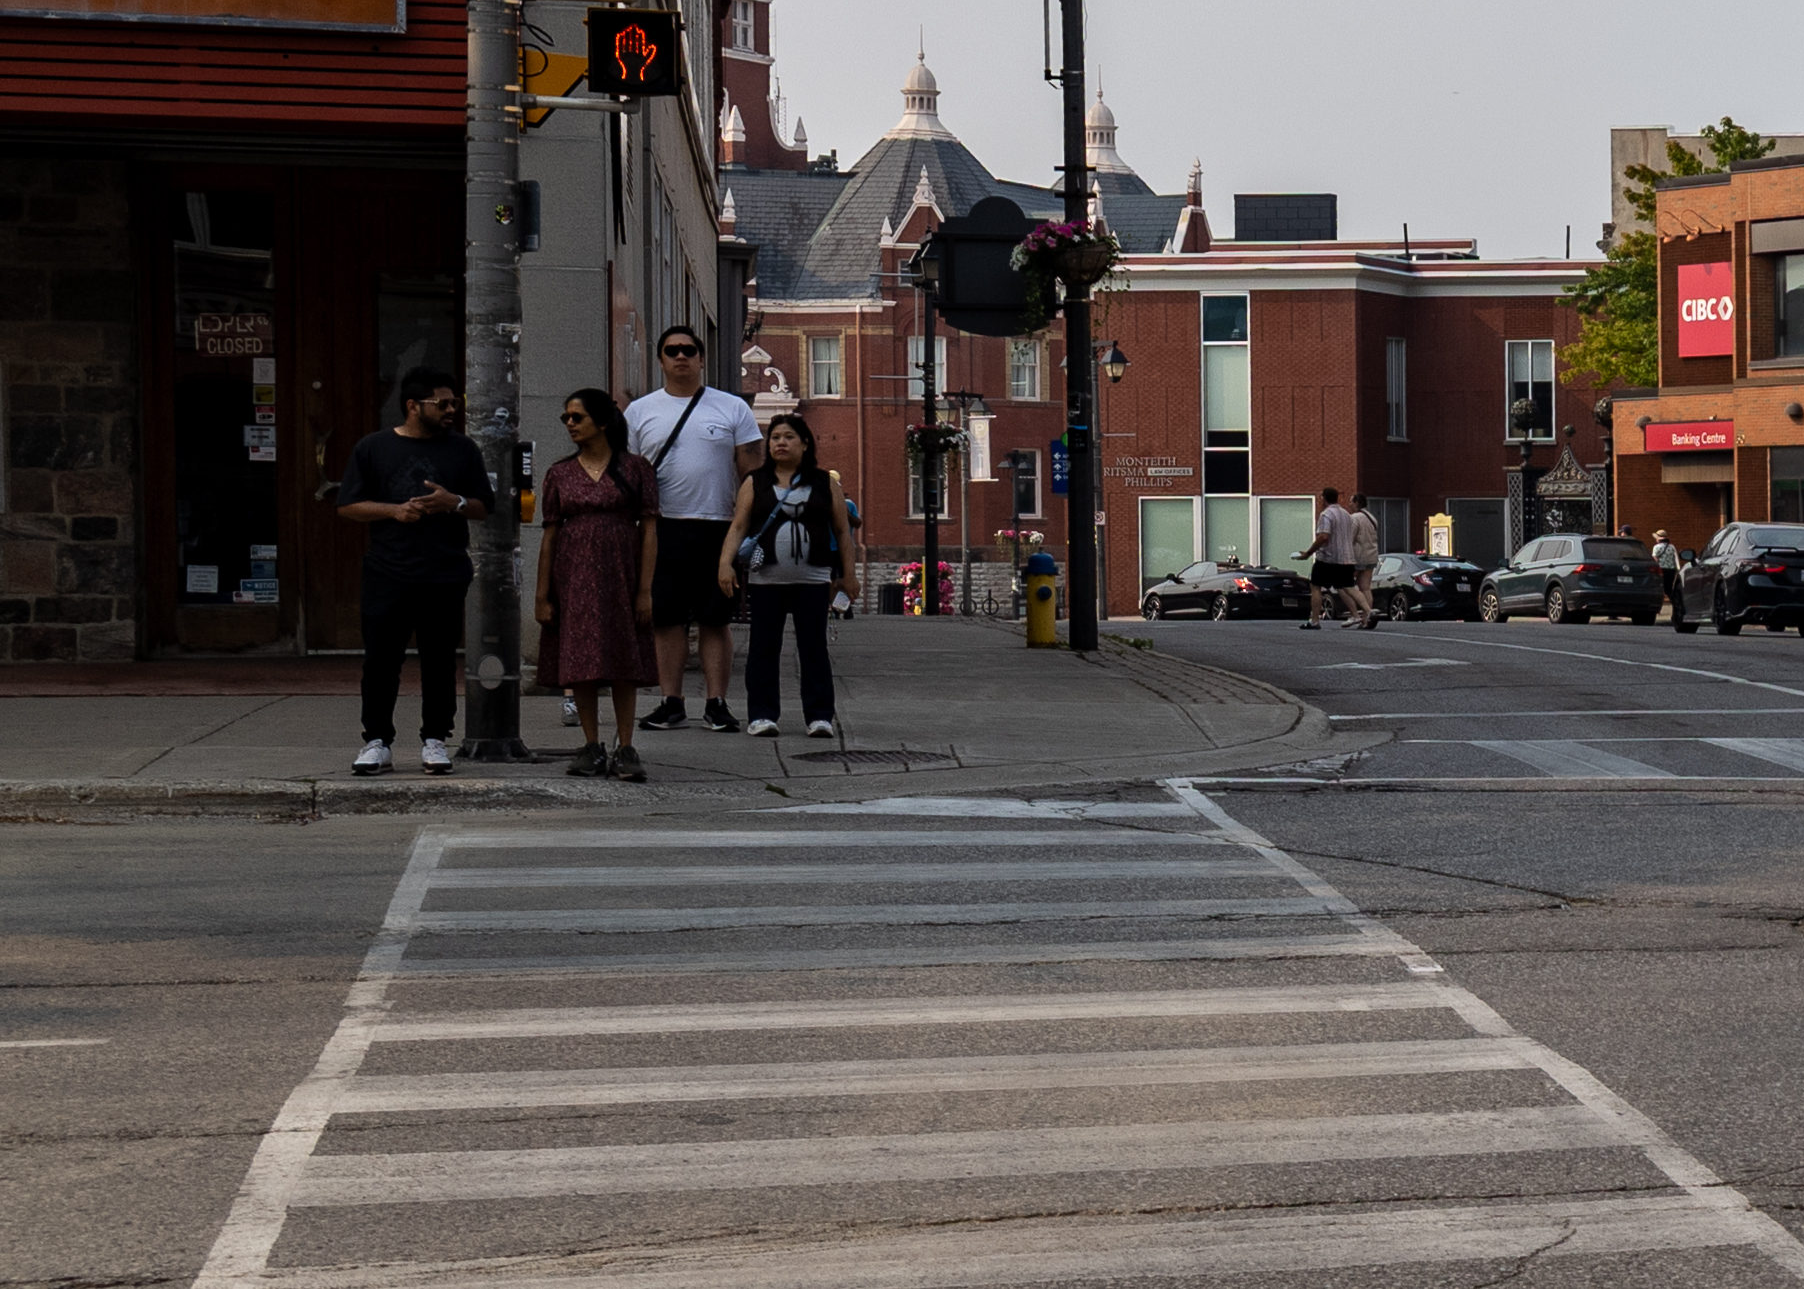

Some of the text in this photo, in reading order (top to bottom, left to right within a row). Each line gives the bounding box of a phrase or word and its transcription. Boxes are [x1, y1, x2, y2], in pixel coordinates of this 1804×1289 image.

[1681, 298, 1718, 322] CIBC
[207, 337, 263, 355] CLOSED
[1671, 432, 1727, 447] Banking Centre
[522, 451, 532, 476] GIVE
[1115, 456, 1177, 467] MONTEITH
[1103, 467, 1145, 477] RITSMA
[1124, 477, 1173, 487] PHILLIPS
